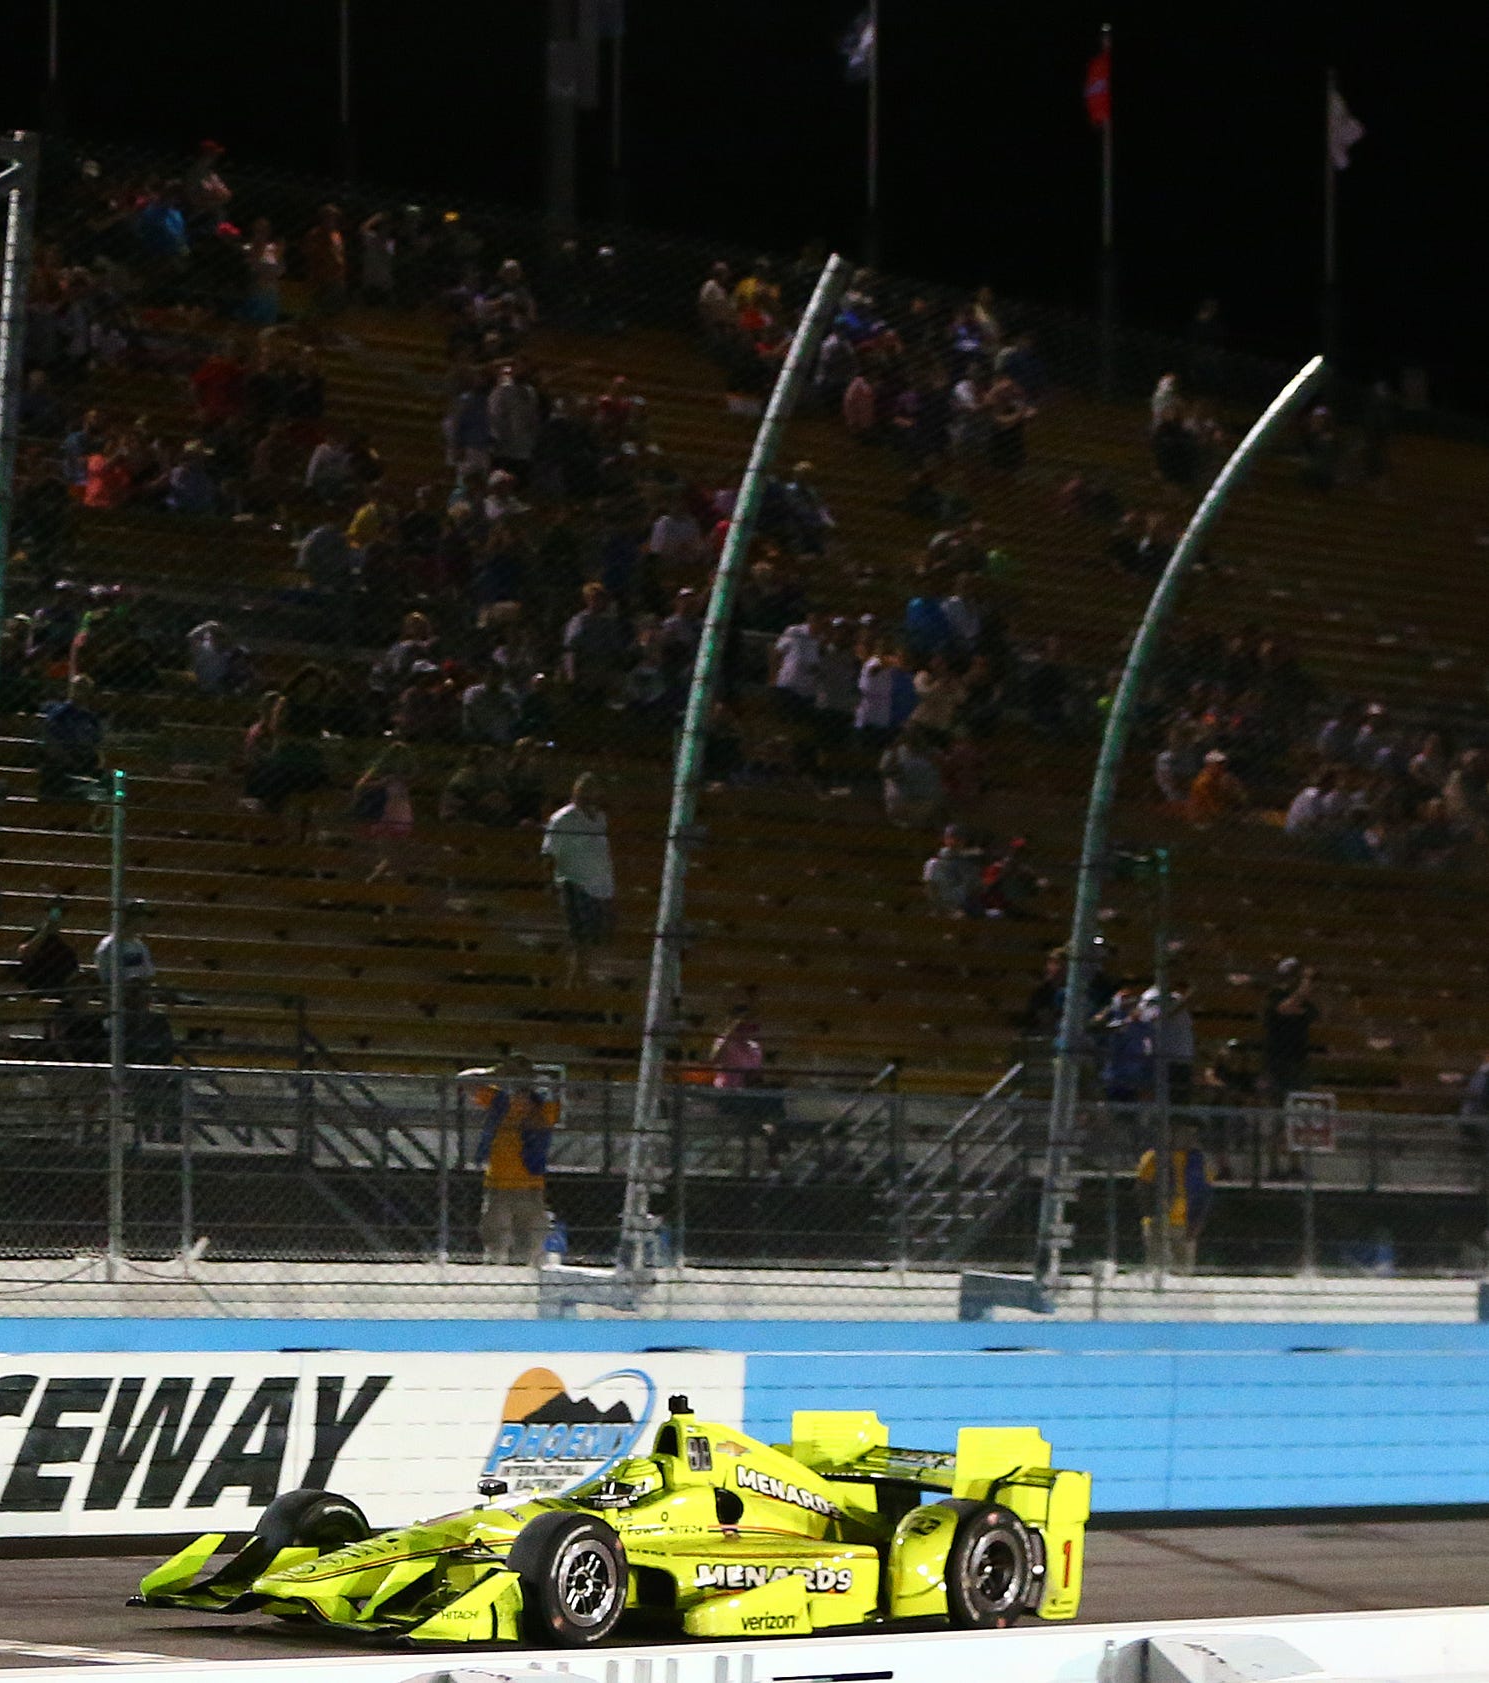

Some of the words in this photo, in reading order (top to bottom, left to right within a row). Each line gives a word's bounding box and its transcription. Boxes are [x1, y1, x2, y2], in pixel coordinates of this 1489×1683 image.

[480, 1422, 640, 1477] PHOENIX
[1063, 1540, 1072, 1588] 1
[441, 1610, 480, 1621] HITACHI
[741, 1611, 796, 1631] verizon
